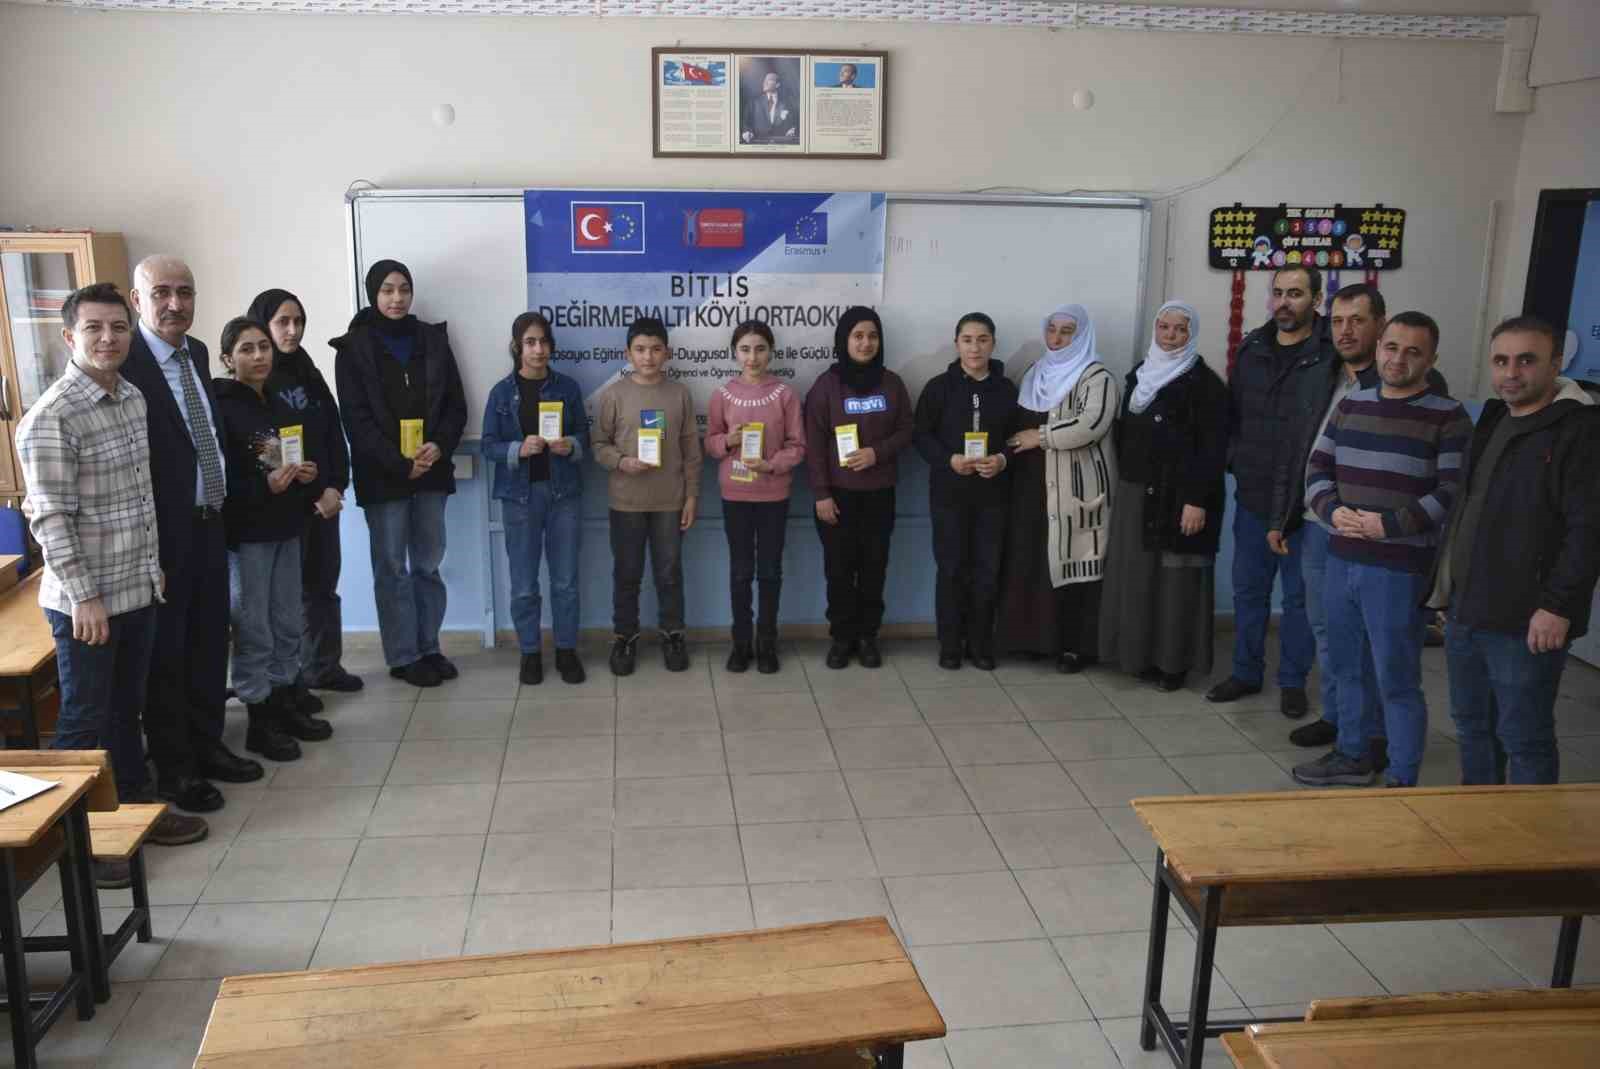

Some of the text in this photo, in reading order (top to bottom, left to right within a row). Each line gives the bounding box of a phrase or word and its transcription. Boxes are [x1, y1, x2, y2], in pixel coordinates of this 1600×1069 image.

[671, 270, 748, 298] BİTLİS
[539, 299, 689, 328] DEĞİRMENALTI
[695, 300, 750, 327] KÖYÜ
[847, 399, 883, 411] mavi
